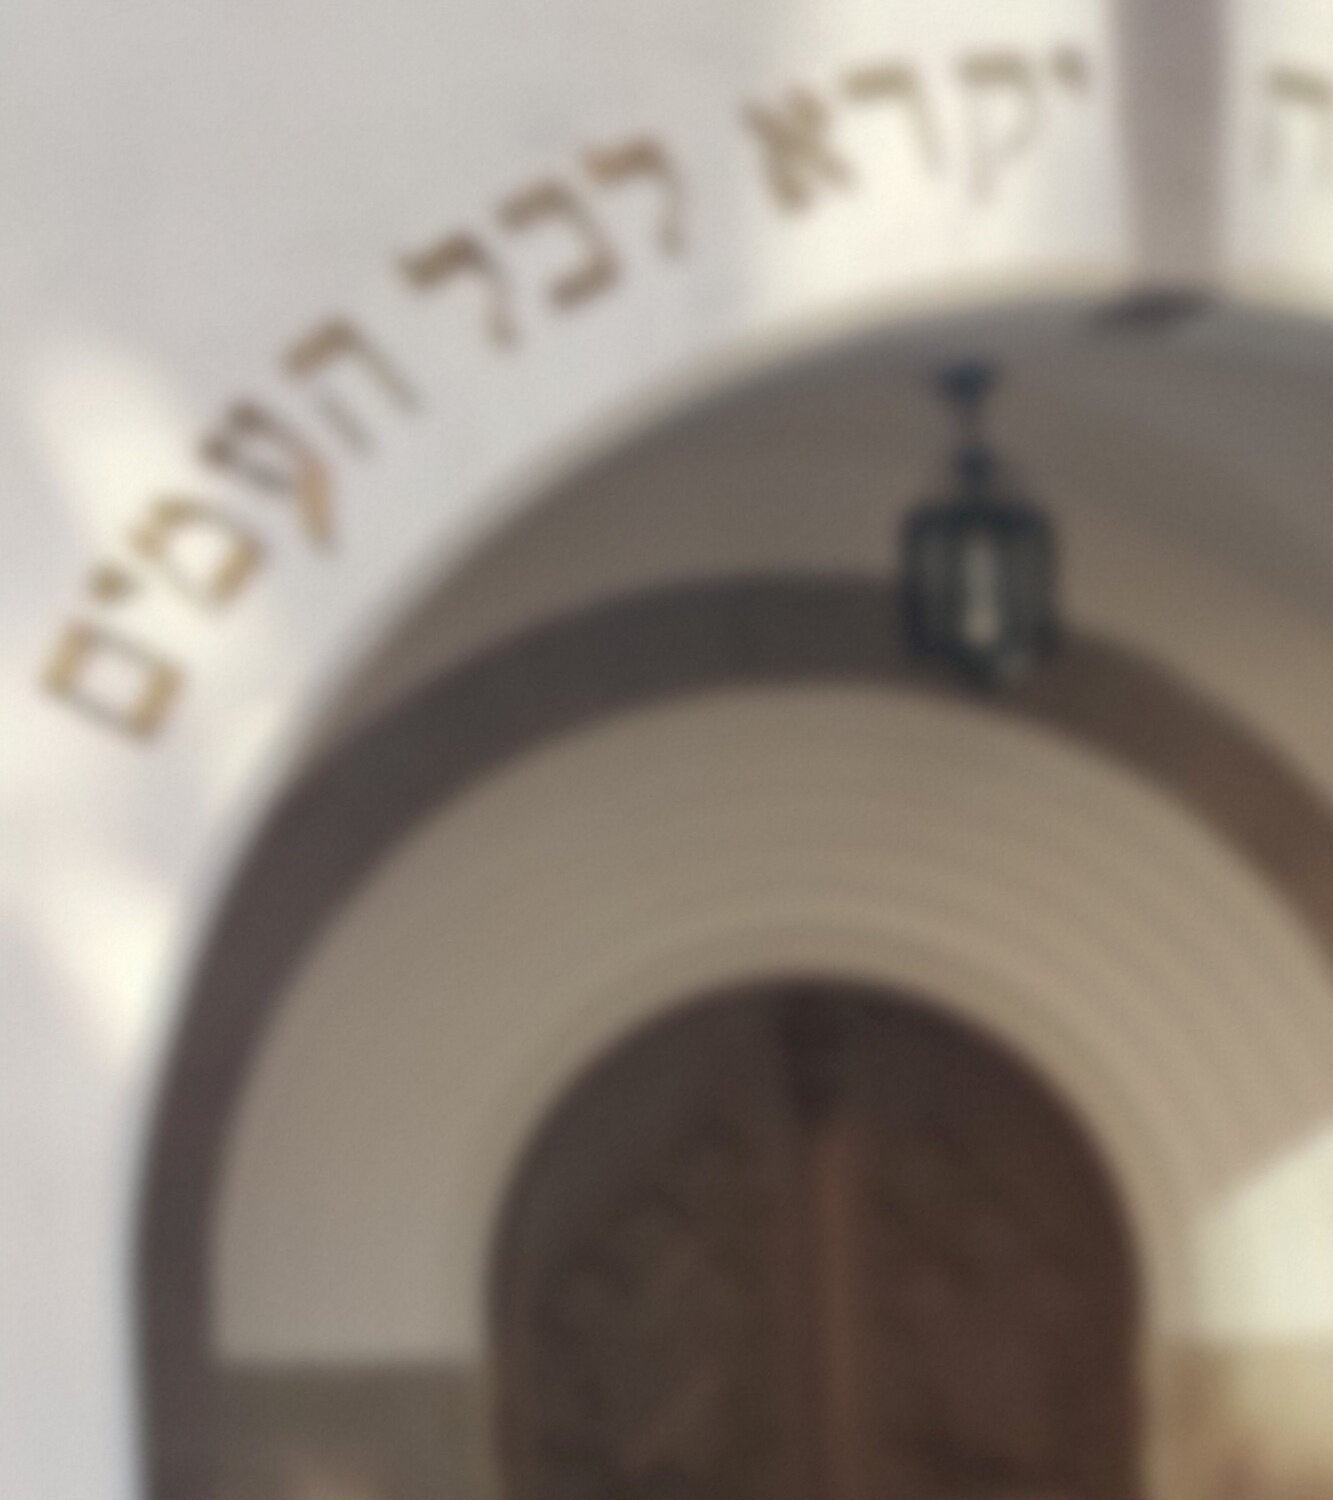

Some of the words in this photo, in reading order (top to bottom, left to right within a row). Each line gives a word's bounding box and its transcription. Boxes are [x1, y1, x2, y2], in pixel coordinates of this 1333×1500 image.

[740, 46, 1090, 216] יקרא
[396, 134, 688, 354] לכל
[36, 316, 424, 742] העמים
